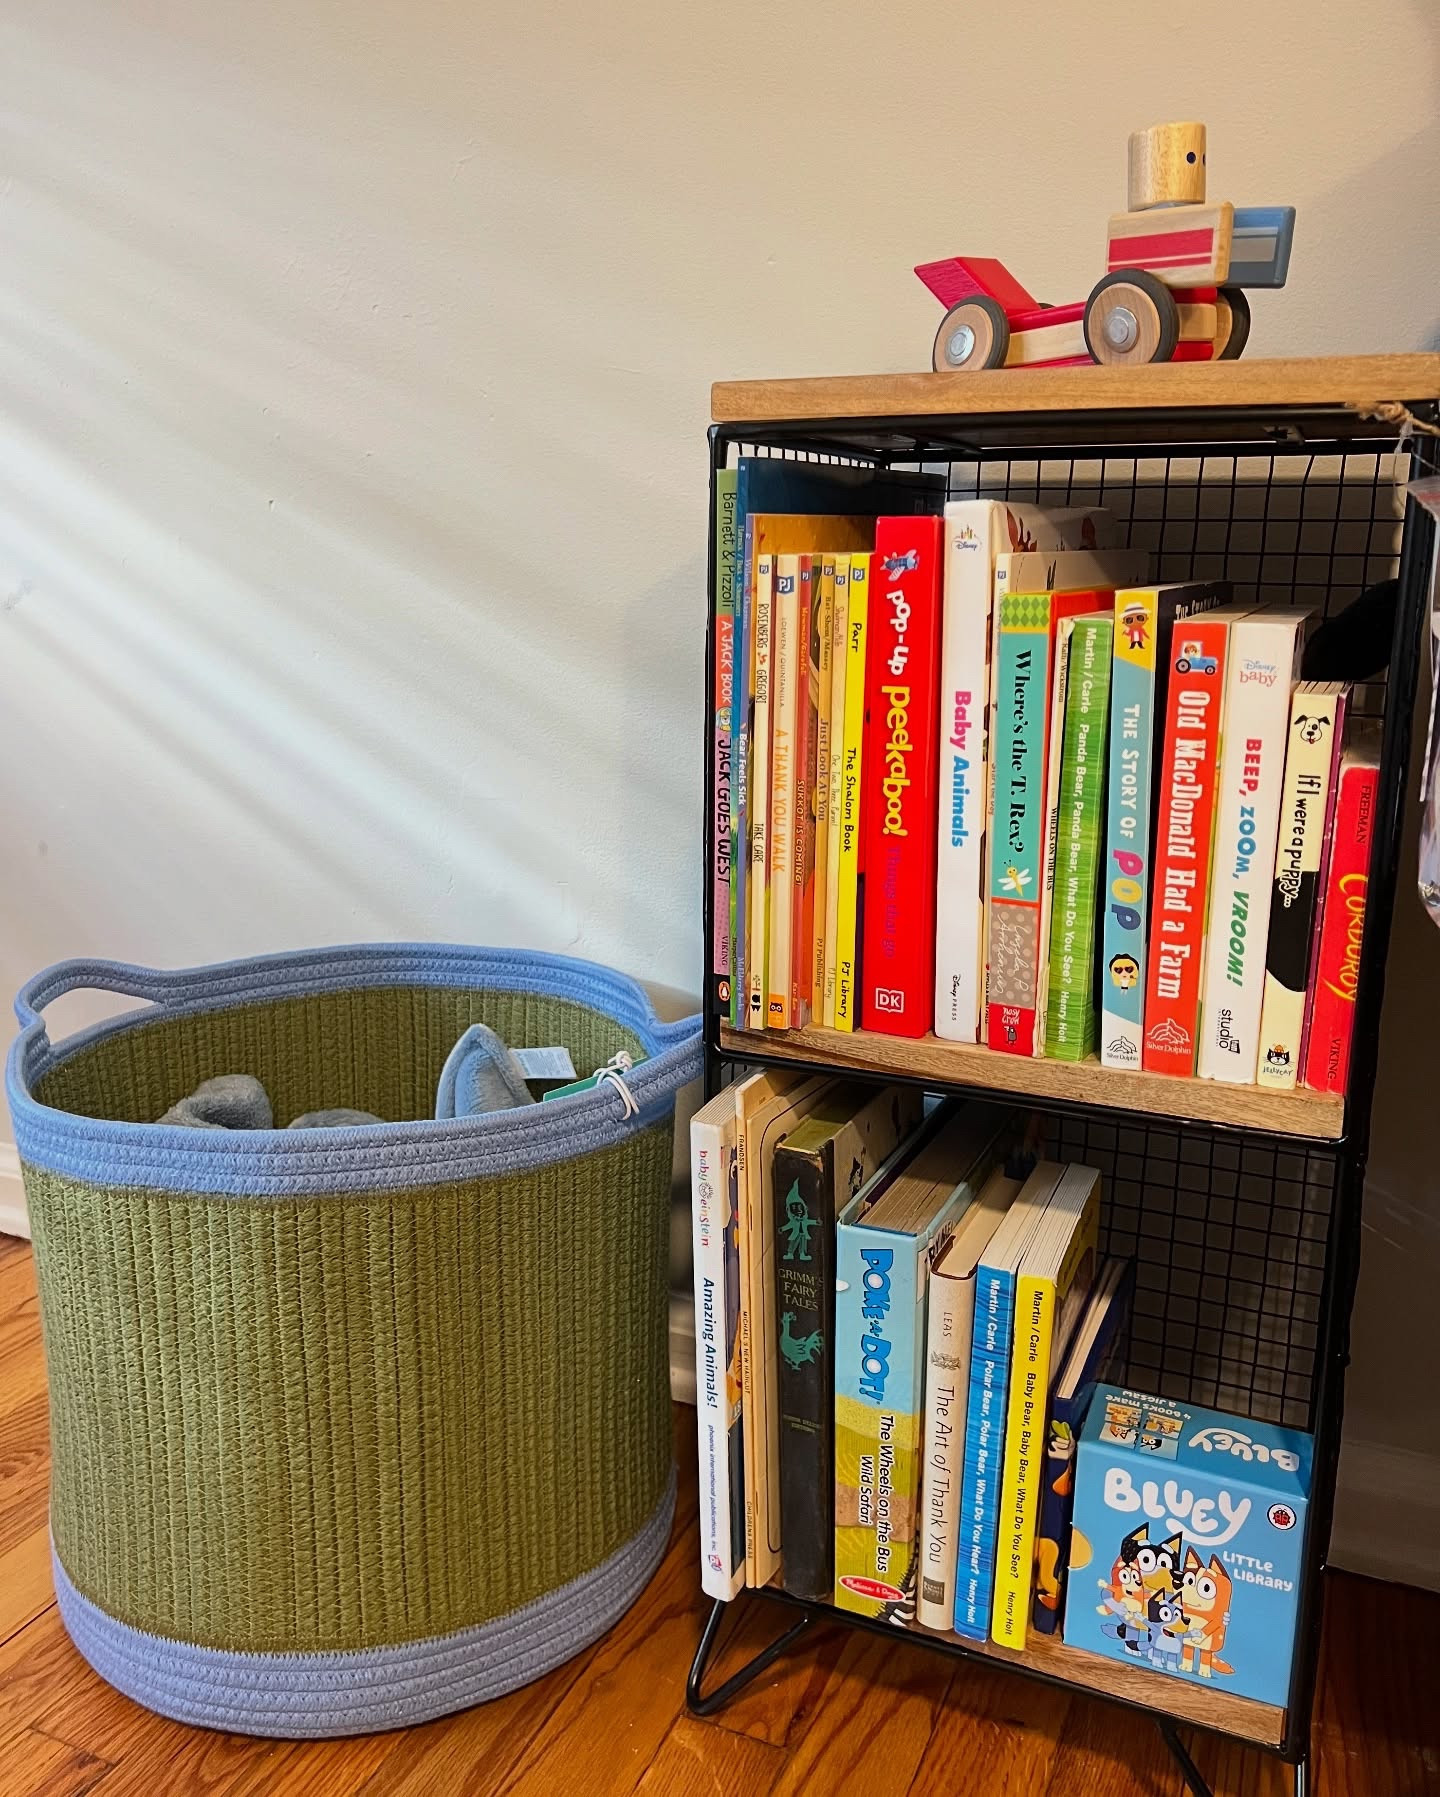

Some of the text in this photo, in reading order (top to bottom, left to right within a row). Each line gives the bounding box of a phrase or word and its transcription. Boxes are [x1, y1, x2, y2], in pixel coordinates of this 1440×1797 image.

[721, 492, 739, 608] Barnett & Pizzoli
[779, 579, 791, 593] PJ
[755, 603, 769, 704] ROSENBERG GREGORI
[780, 617, 788, 650] LOEWEN
[851, 622, 863, 653] Parr
[886, 589, 912, 676] pop-up
[721, 620, 733, 706] A JACK BOOK
[1080, 627, 1098, 714] Martin Carle
[1239, 670, 1278, 688] baby
[738, 733, 748, 806] Bear Feels Sick
[817, 718, 829, 822] Just Look At You
[881, 685, 914, 837] peekaboo!
[949, 690, 972, 848] Baby Animals
[1008, 649, 1032, 853] Where's the T. Rex?
[1119, 748, 1140, 810] STORY
[1238, 737, 1263, 797] BEEP,
[771, 729, 789, 873] A THANK YOU WALK
[843, 747, 857, 852] The Shalom Book
[1298, 774, 1321, 789] If
[717, 739, 731, 889] JACK GOES WEST
[752, 822, 765, 863] TAKE CARE
[794, 779, 806, 887] SUKKOT IS COMING!
[1156, 690, 1211, 998] Old MacDonald Had a Farm
[1291, 837, 1303, 848] a
[1292, 798, 1309, 837] were
[1356, 784, 1373, 844] FREEMAN
[1046, 807, 1058, 891] WHEELS ON THE BUS
[1056, 723, 1091, 1044] Panda Bear, Panda Bear, What Do You See? Henry Holt
[1111, 849, 1144, 931] POP
[720, 935, 730, 966] VIKING
[815, 937, 824, 988] PJ Publishing
[881, 940, 895, 958] go
[1226, 889, 1251, 987] VROOM!
[1321, 873, 1369, 1002] CORDUROY
[837, 961, 851, 1019] PJ Library
[878, 995, 902, 1010] DK
[1218, 1008, 1235, 1049] studio
[1327, 1037, 1342, 1080] VIKING
[738, 1134, 746, 1172] FRANDSEN
[697, 1149, 714, 1247] baby einstein
[783, 1281, 818, 1298] FAIRY
[783, 1293, 819, 1311] TALES
[702, 1276, 719, 1410] Amazing Animals!
[942, 1311, 953, 1337] LEAS
[935, 1385, 955, 1418] The
[707, 1424, 717, 1453] phoenix
[929, 1454, 952, 1474] of
[934, 1420, 953, 1448] Art
[966, 1278, 1001, 1624] Martin Carle Polar Bear, Polar Bear, What Do You Hear? Henry Holt
[1004, 1290, 1044, 1635] Martin Carle Baby Bear, Baby Bear, What Do You See? Henry Holt
[1188, 1427, 1300, 1473] BLUEY
[709, 1453, 718, 1497] international
[860, 1456, 873, 1525] Wild Safari
[877, 1415, 895, 1572] The Wheels on the Bus
[929, 1478, 951, 1529] Thank
[1103, 1466, 1252, 1546] BLUEY
[928, 1533, 948, 1564] You
